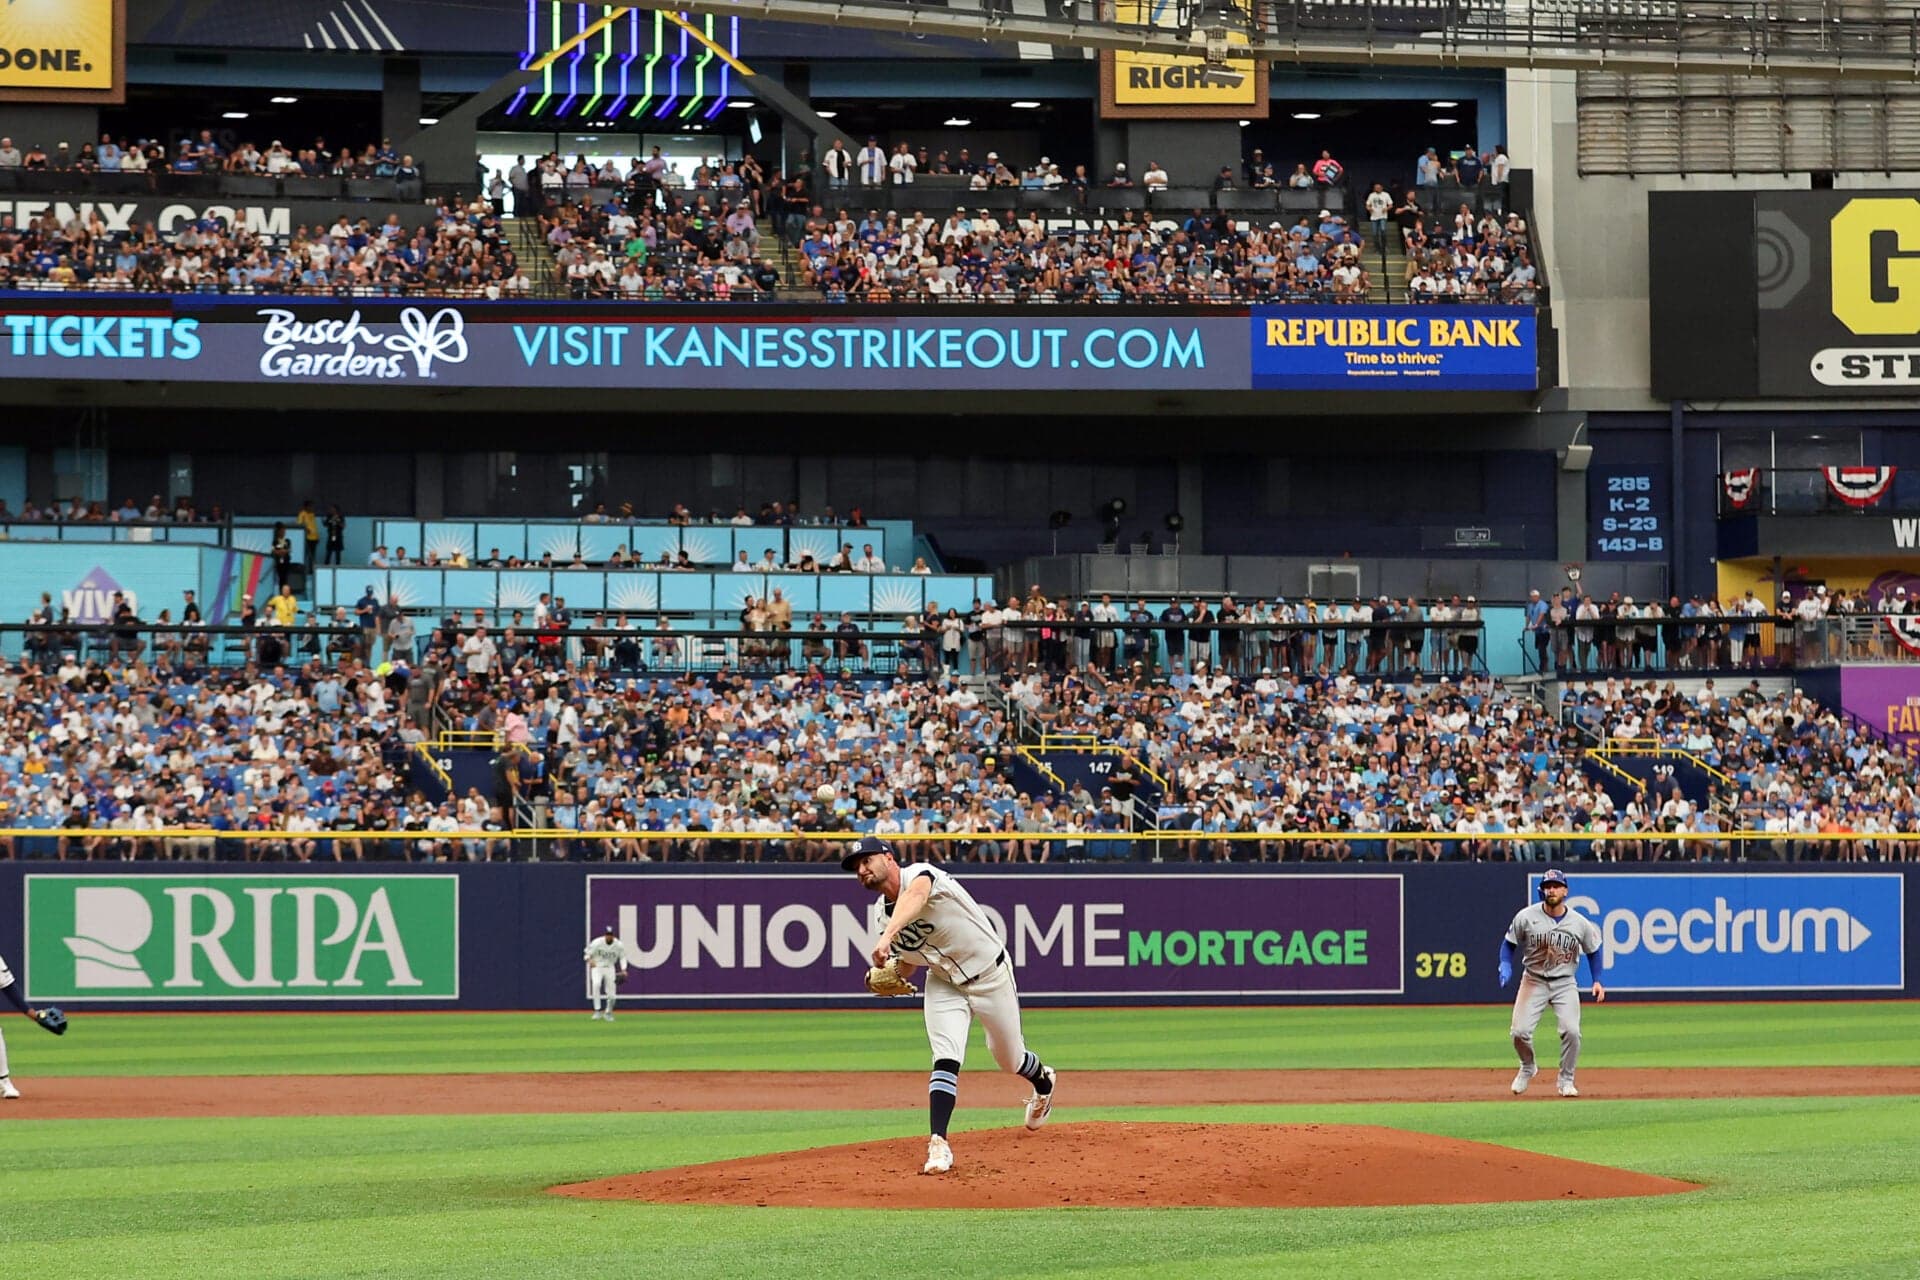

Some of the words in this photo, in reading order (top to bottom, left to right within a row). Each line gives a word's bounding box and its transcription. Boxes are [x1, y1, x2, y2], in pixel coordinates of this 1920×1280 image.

[1130, 66, 1241, 89] RIGH
[4, 315, 202, 360] TICKETS
[257, 309, 384, 345] Busch
[1266, 319, 1421, 347] REPUBLIC
[1429, 319, 1522, 347] BANK
[513, 325, 629, 369] VISIT
[645, 325, 1206, 369] KANESSTRIKEOUT.COM
[1345, 352, 1379, 364] Time
[1381, 352, 1396, 364] to
[260, 342, 404, 378] Gardens
[1608, 476, 1651, 492] 285
[1609, 497, 1650, 512] K-2
[1602, 516, 1658, 532] S-23
[1598, 536, 1663, 552] 143-B
[1088, 761, 1112, 774] 147
[163, 886, 424, 988] RIPA
[619, 903, 880, 970] UNION
[978, 903, 1126, 968] ME
[1128, 929, 1369, 967] MORTGAGE
[1529, 931, 1579, 953] CHICAGO
[1415, 952, 1467, 979] 378
